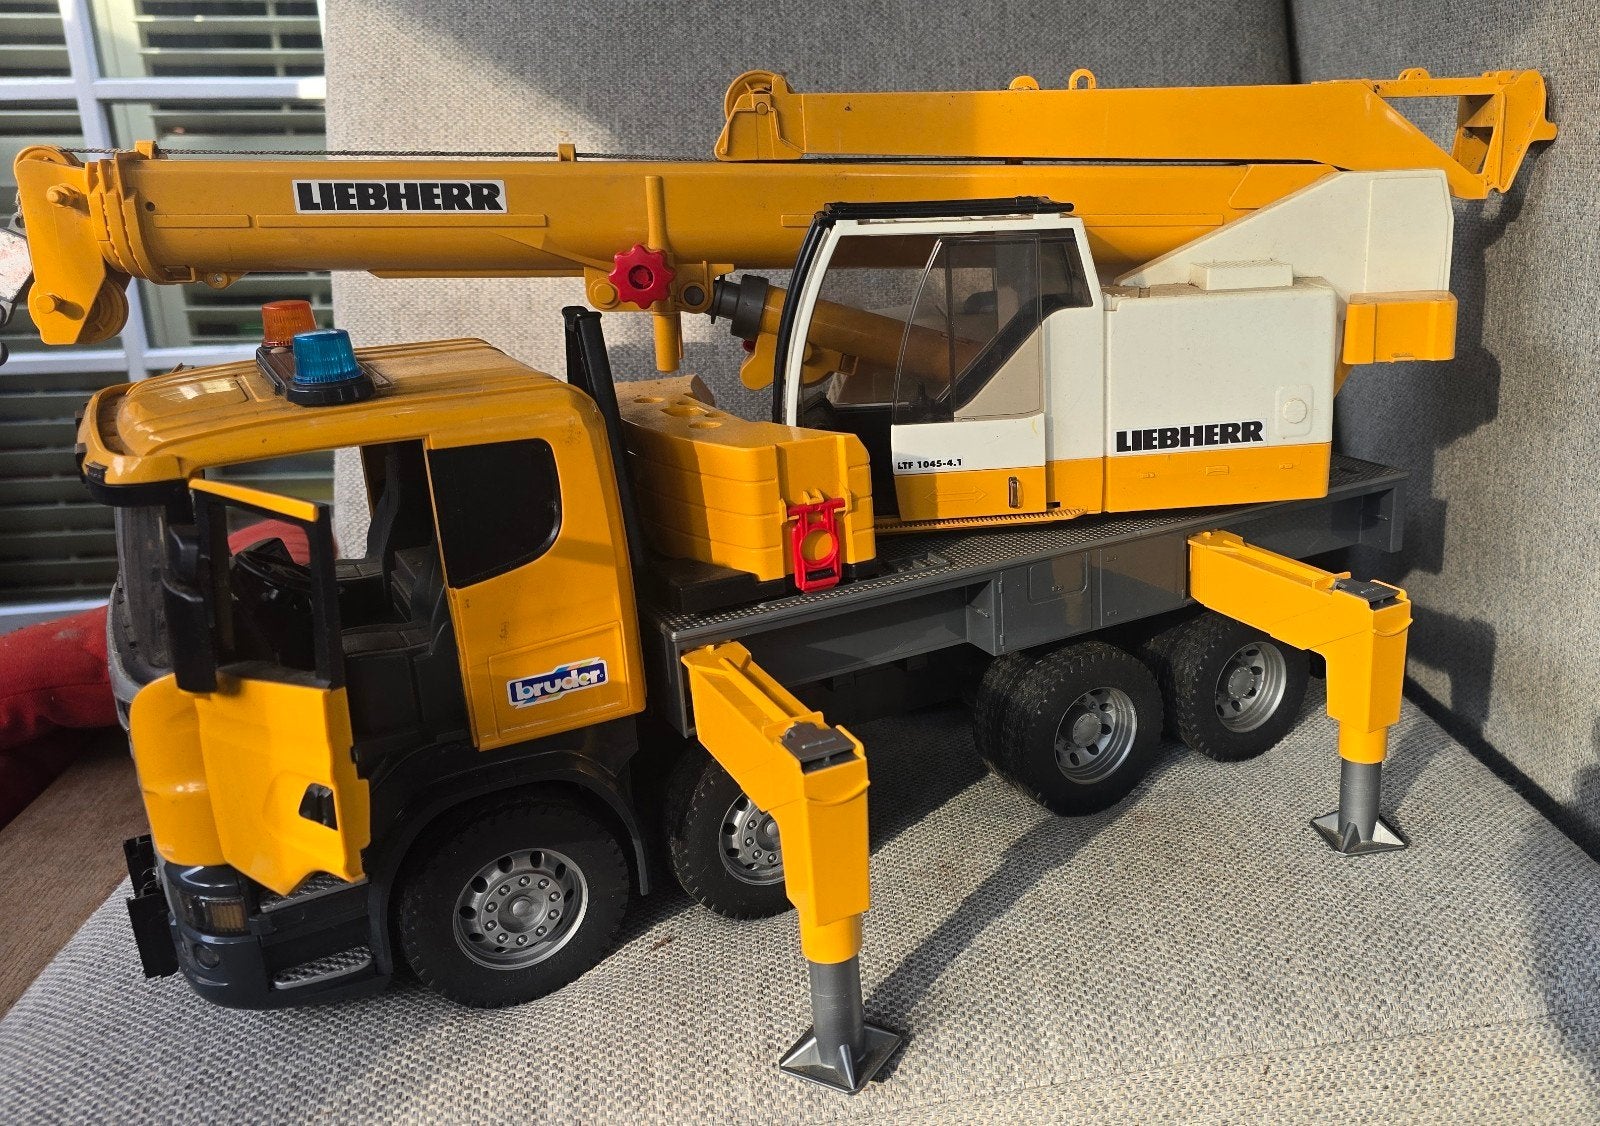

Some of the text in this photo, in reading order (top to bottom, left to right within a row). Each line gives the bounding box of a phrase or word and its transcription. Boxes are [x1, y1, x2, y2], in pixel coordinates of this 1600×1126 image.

[296, 182, 504, 211] LIEBHERR
[1116, 420, 1264, 453] LIEBHERR
[897, 458, 962, 470] LTF 1045-4.1
[515, 669, 600, 701] bruder
